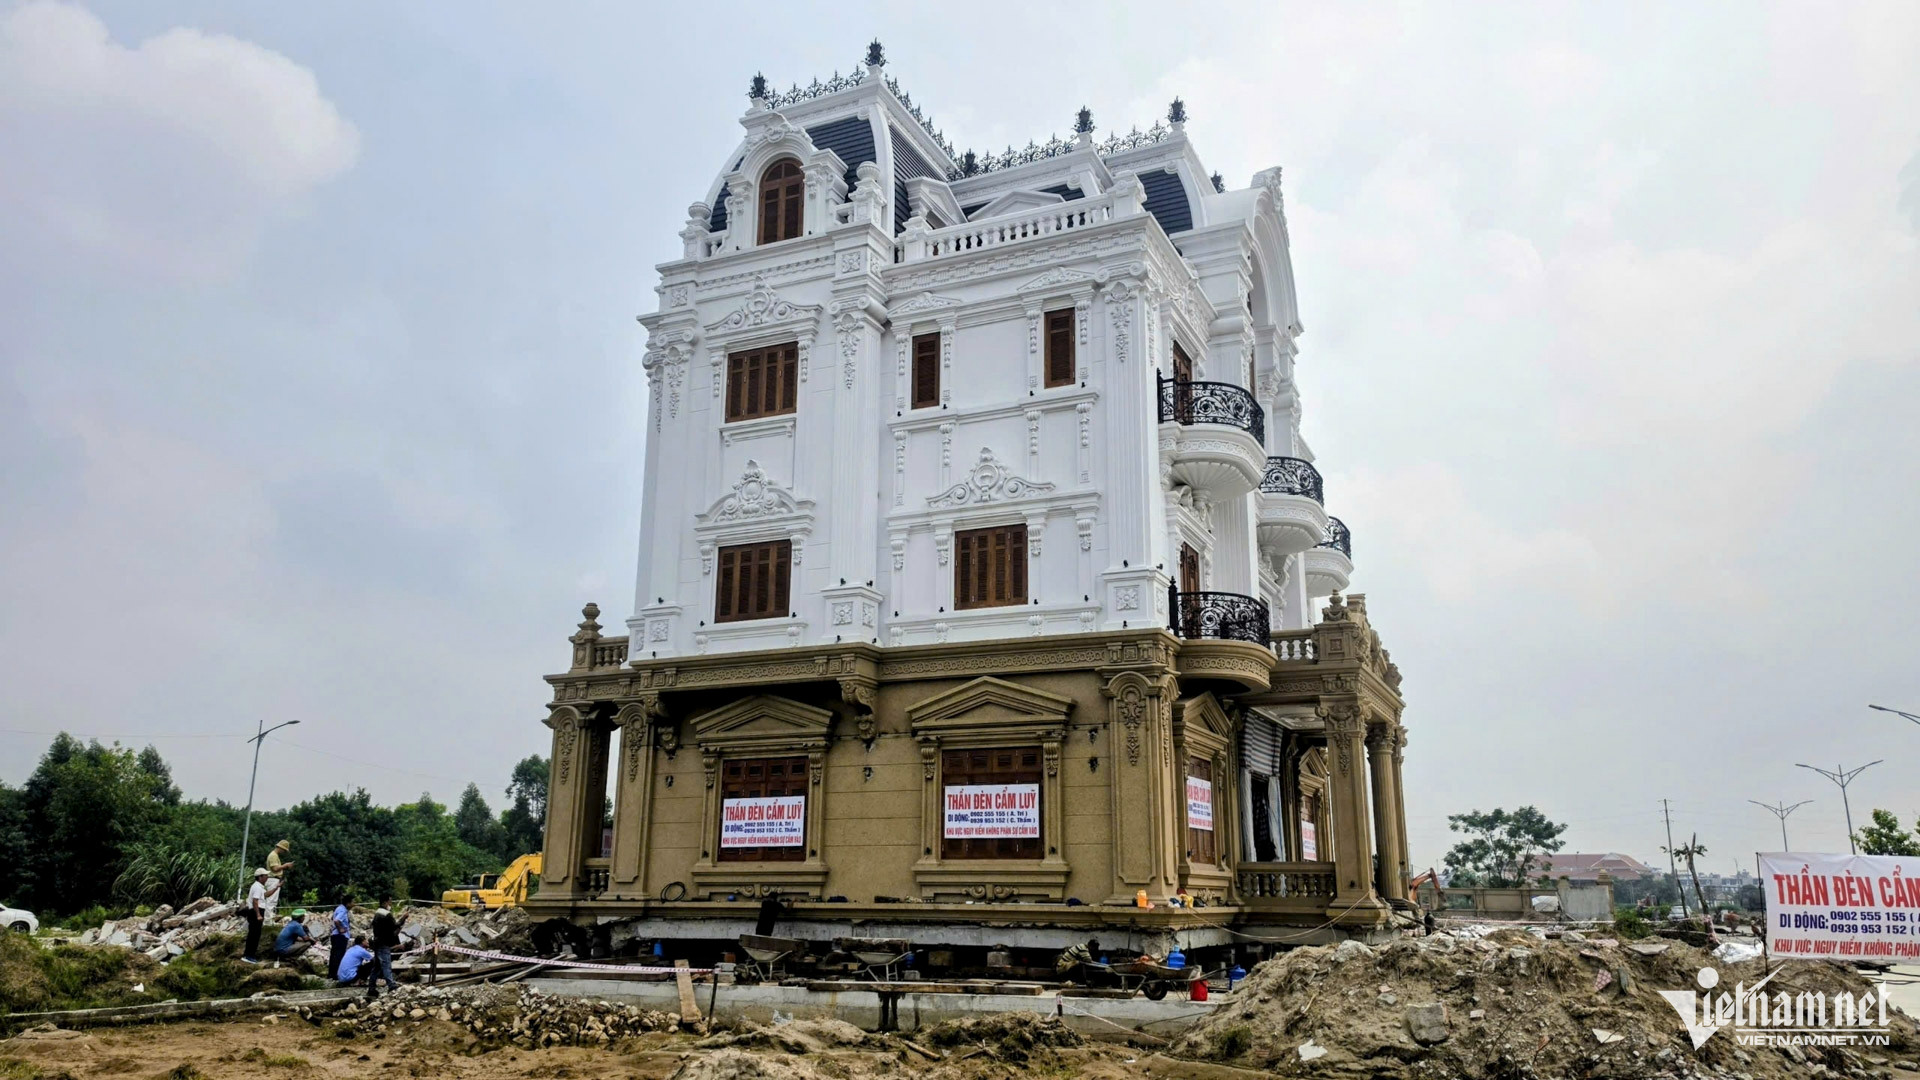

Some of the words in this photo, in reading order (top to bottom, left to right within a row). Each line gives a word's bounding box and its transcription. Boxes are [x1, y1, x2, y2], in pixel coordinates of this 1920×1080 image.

[974, 790, 992, 809] ĐÈN
[748, 802, 764, 820] ĐÈN
[955, 813, 969, 823] ĐỘNG:
[1773, 864, 1830, 906] THẦN
[1833, 870, 1875, 907] ĐÈN
[1780, 913, 1790, 927] DI
[1794, 911, 1829, 932] ĐỘNG:
[1830, 911, 1857, 920] 0902
[1861, 912, 1881, 921] 555
[1885, 912, 1906, 921] 155
[1830, 924, 1858, 934] 0939
[1861, 924, 1882, 934] 953
[1886, 925, 1906, 934] 152
[1774, 938, 1792, 952] KHU
[1795, 938, 1812, 955] VỰC
[1814, 940, 1837, 954] NGUY
[1839, 936, 1861, 955] HIỂM
[1864, 939, 1892, 956] KHÔNG
[1895, 940, 1920, 960] PHẬN
